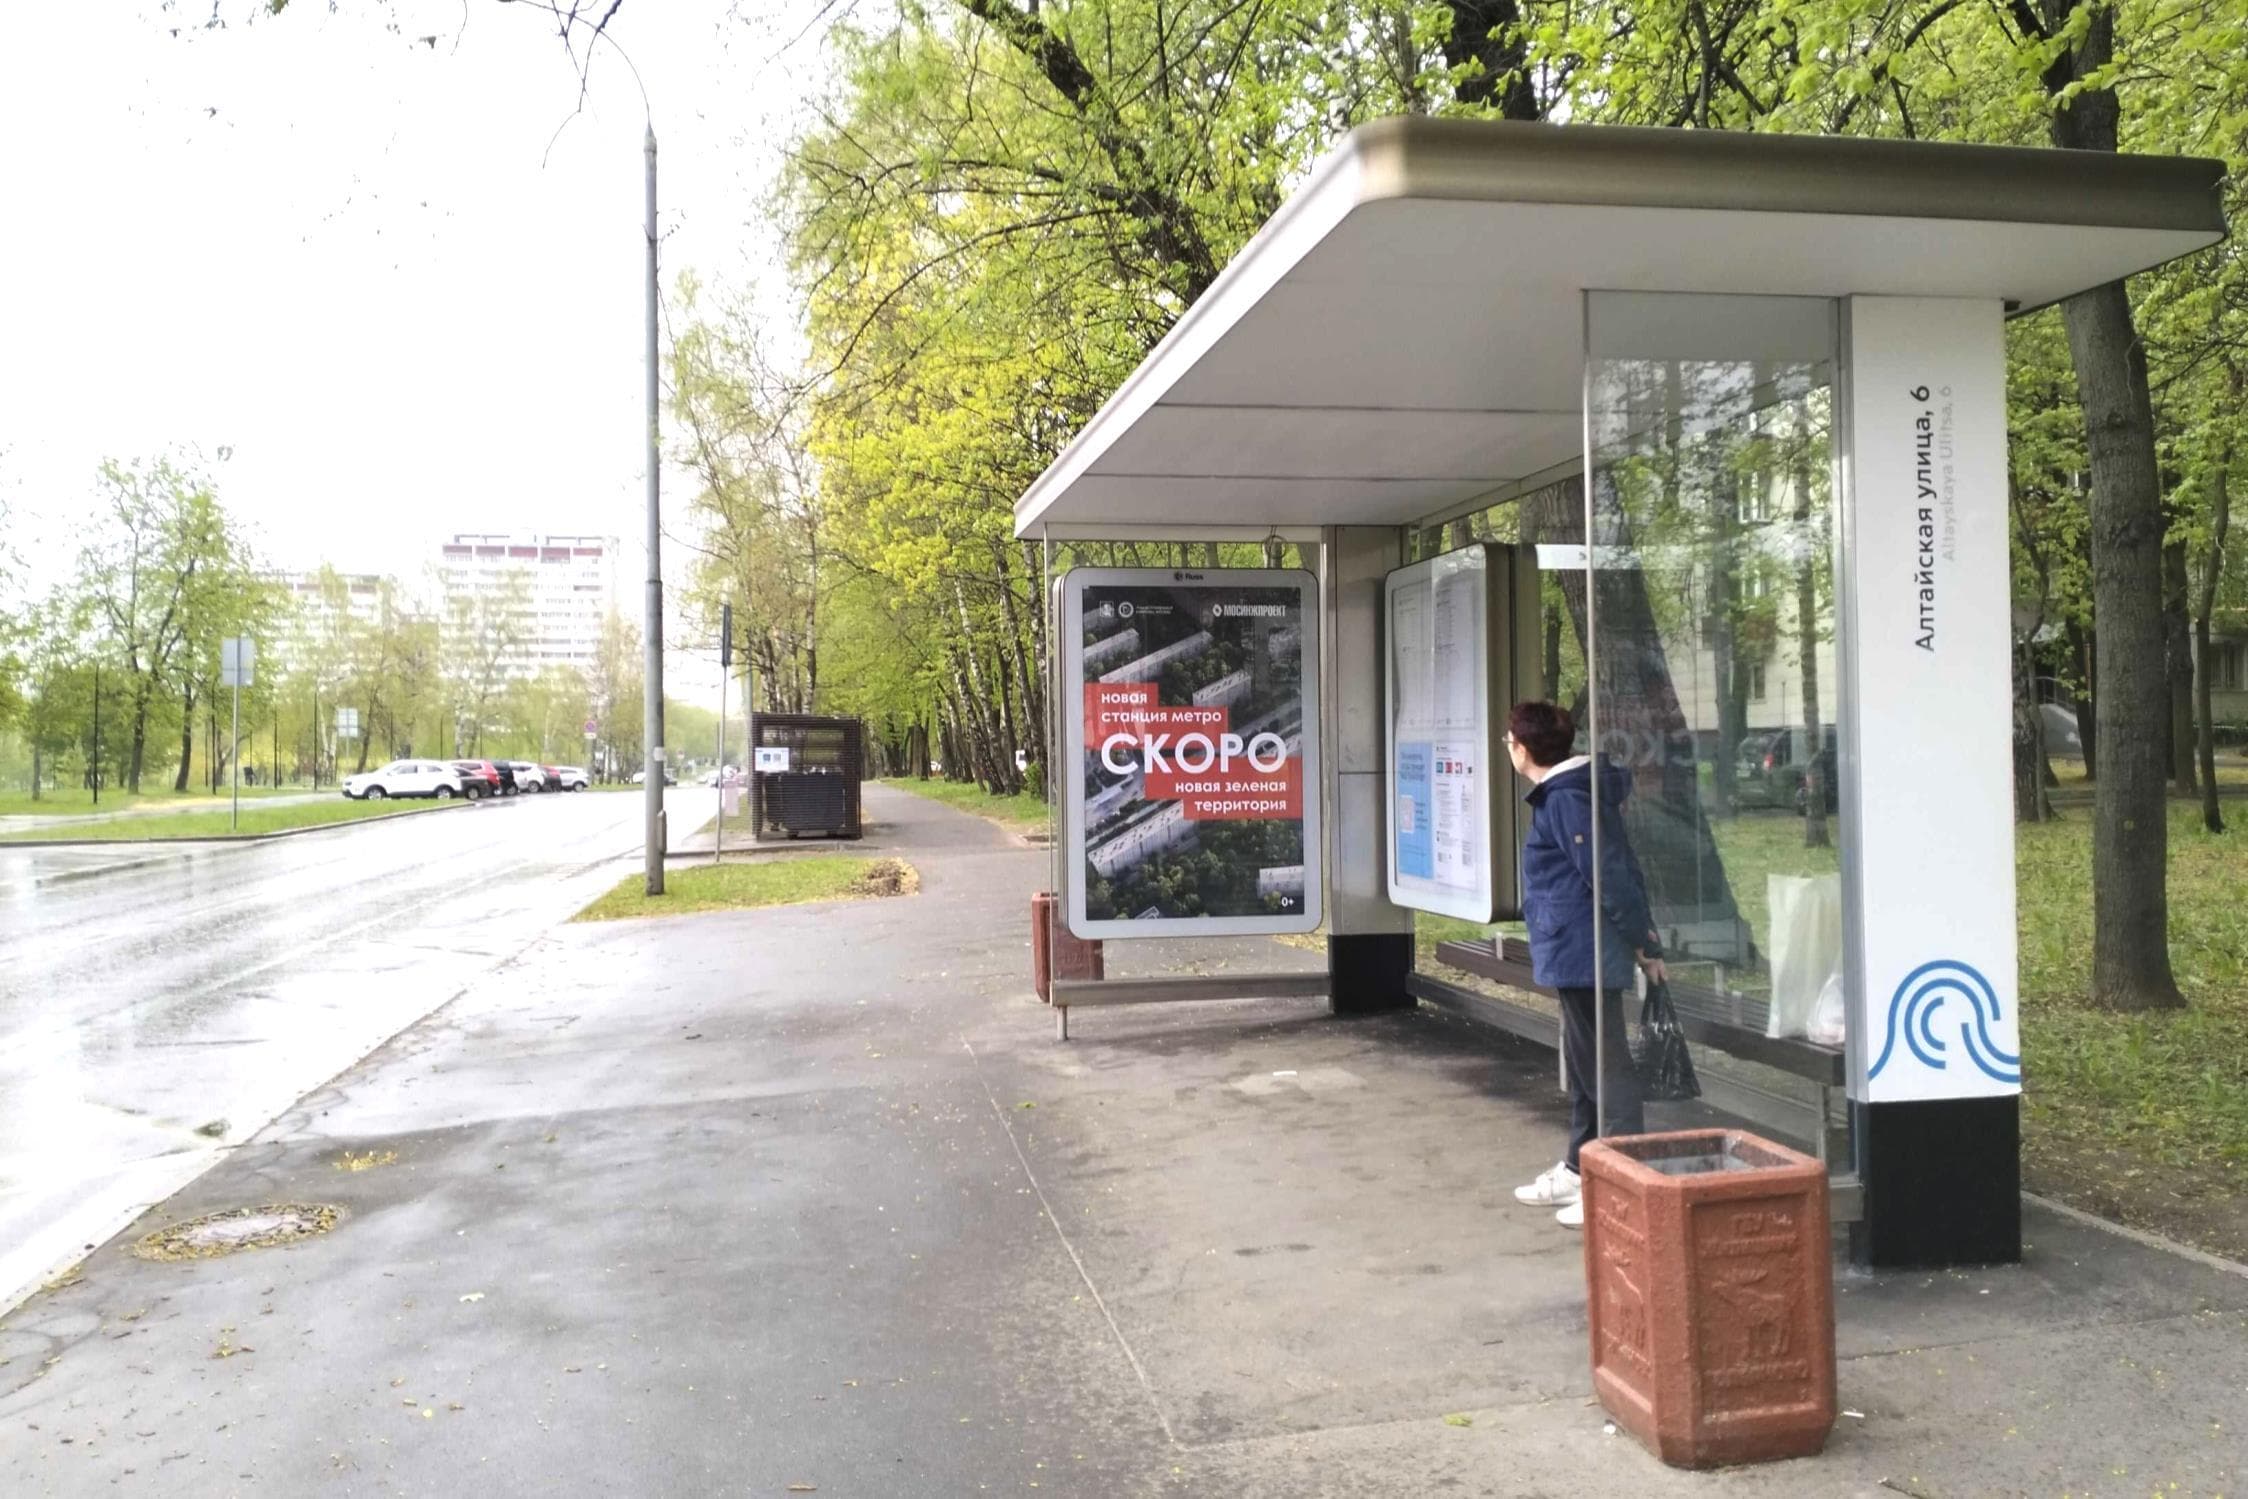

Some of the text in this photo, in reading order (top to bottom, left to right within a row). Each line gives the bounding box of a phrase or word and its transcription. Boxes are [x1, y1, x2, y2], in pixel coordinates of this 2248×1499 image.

[1939, 384, 1956, 562] Altayskaya Ulitsa, 6
[1910, 384, 1937, 652] Алтайская улица, 6
[1223, 604, 1287, 617] МОСИНЖПРОЕКТ
[1101, 693, 1148, 705] новая
[1101, 711, 1222, 725] станция метро
[1101, 732, 1287, 775] СКОРО
[1175, 780, 1287, 793] новая зеленая
[1194, 799, 1287, 814] территория
[1281, 896, 1294, 908] 0+
